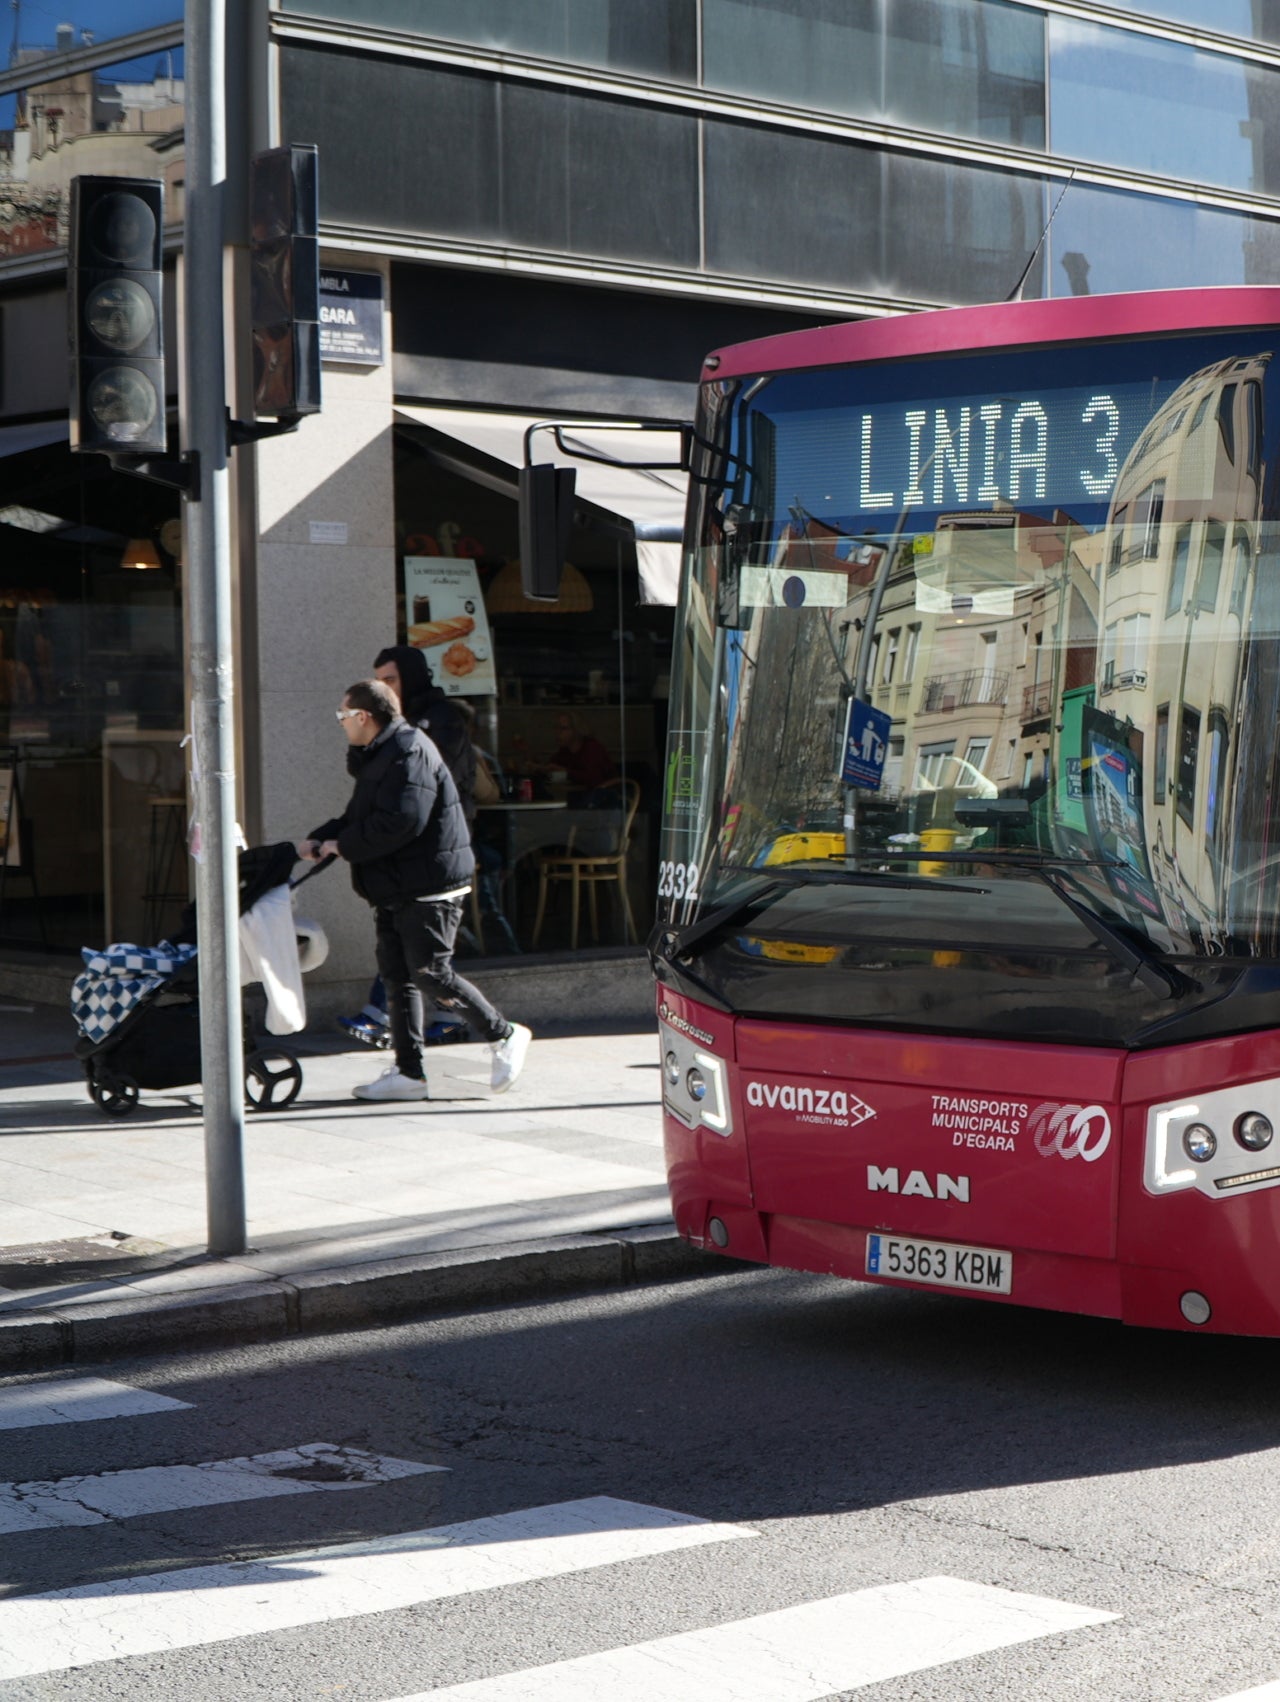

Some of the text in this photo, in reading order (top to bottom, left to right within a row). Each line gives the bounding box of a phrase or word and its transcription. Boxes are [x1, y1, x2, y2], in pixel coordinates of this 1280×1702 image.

[319, 277, 350, 292] MBLA
[860, 395, 1120, 508] LINIA 3
[658, 861, 699, 900] 2332
[746, 1081, 849, 1117] avanza
[931, 1095, 1028, 1120] TRANSPORTS
[801, 1114, 833, 1126] MOBILITY
[833, 1118, 849, 1127] ADO
[931, 1113, 1020, 1136] MUNICIPALS
[953, 1132, 1015, 1153] D'EGARA
[867, 1165, 970, 1203] MAN
[870, 1242, 1001, 1288] E 5363 KBM
